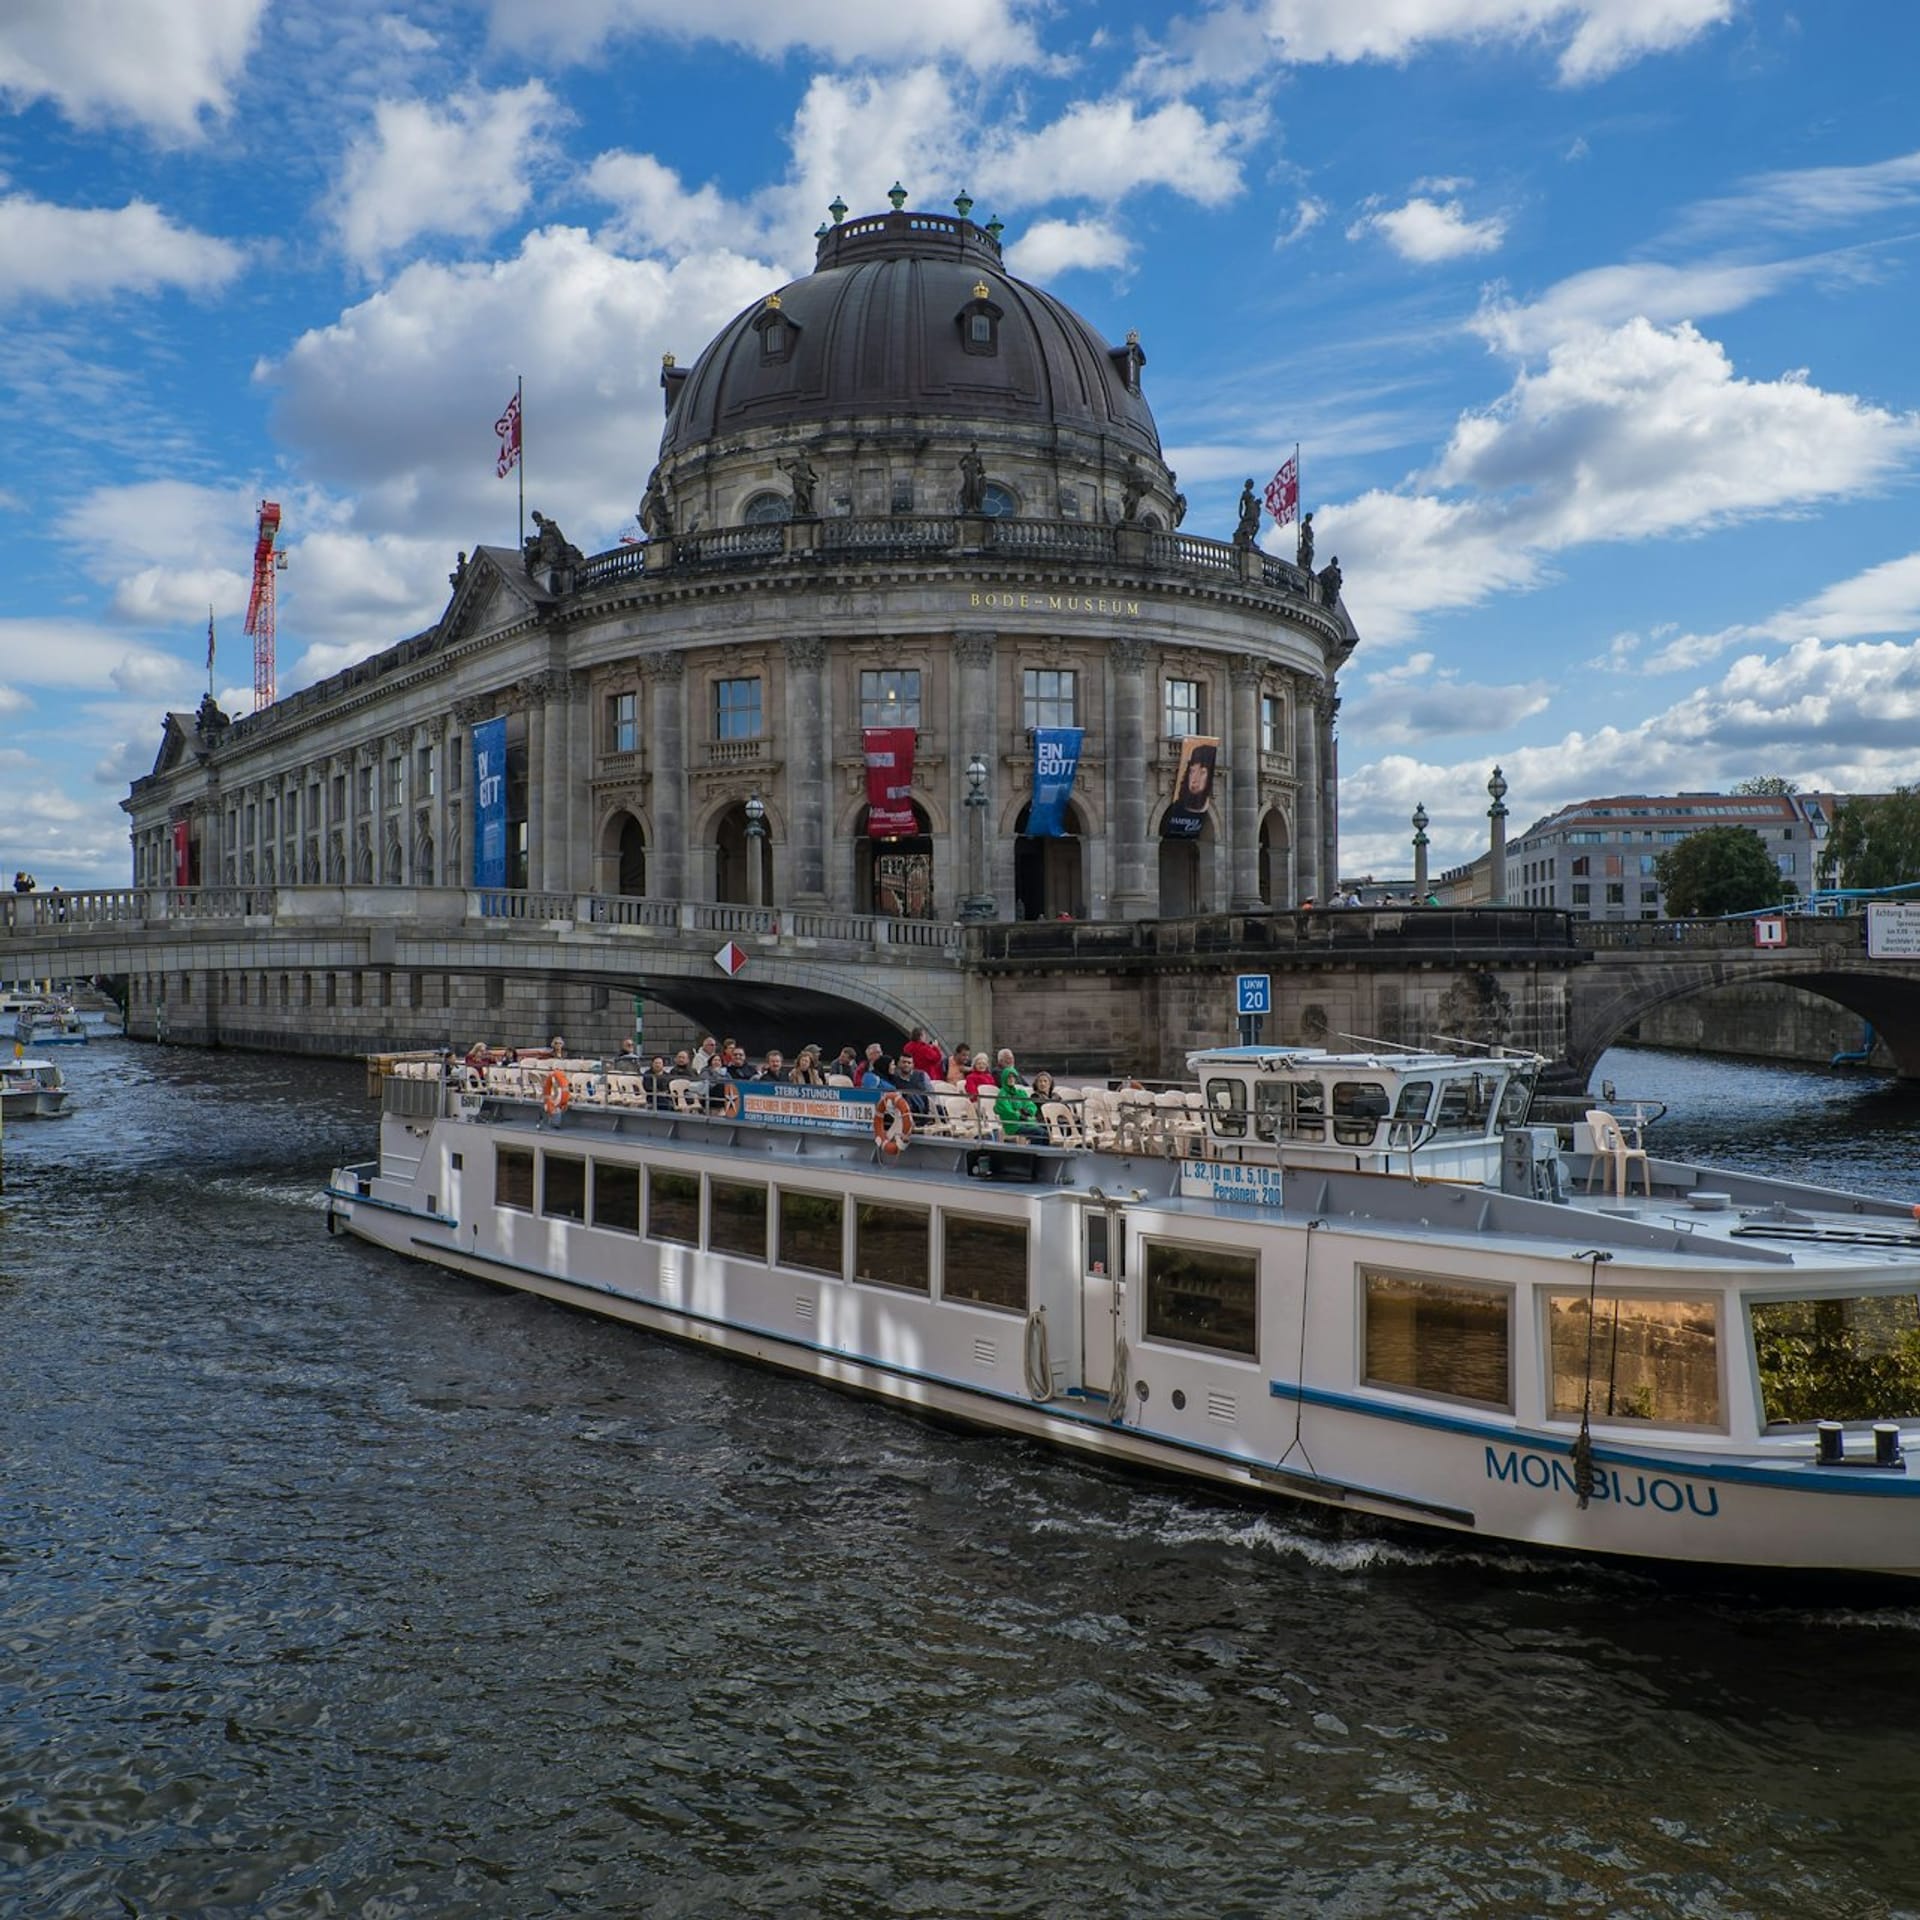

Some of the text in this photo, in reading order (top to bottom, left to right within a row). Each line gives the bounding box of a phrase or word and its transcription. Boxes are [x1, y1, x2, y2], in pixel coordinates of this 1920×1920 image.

[970, 593, 1139, 615] BODE-MUSEUM
[1038, 743, 1063, 760] EIN
[1037, 759, 1076, 775] GOTT
[1243, 980, 1265, 990] UKW
[1245, 991, 1263, 1009] 20
[774, 1085, 840, 1100] STERN-STUNDEN
[1194, 1162, 1220, 1181] 32,10
[1247, 1167, 1269, 1186] 5,10
[1271, 1172, 1280, 1187] m
[1213, 1182, 1280, 1205] Personen: 200
